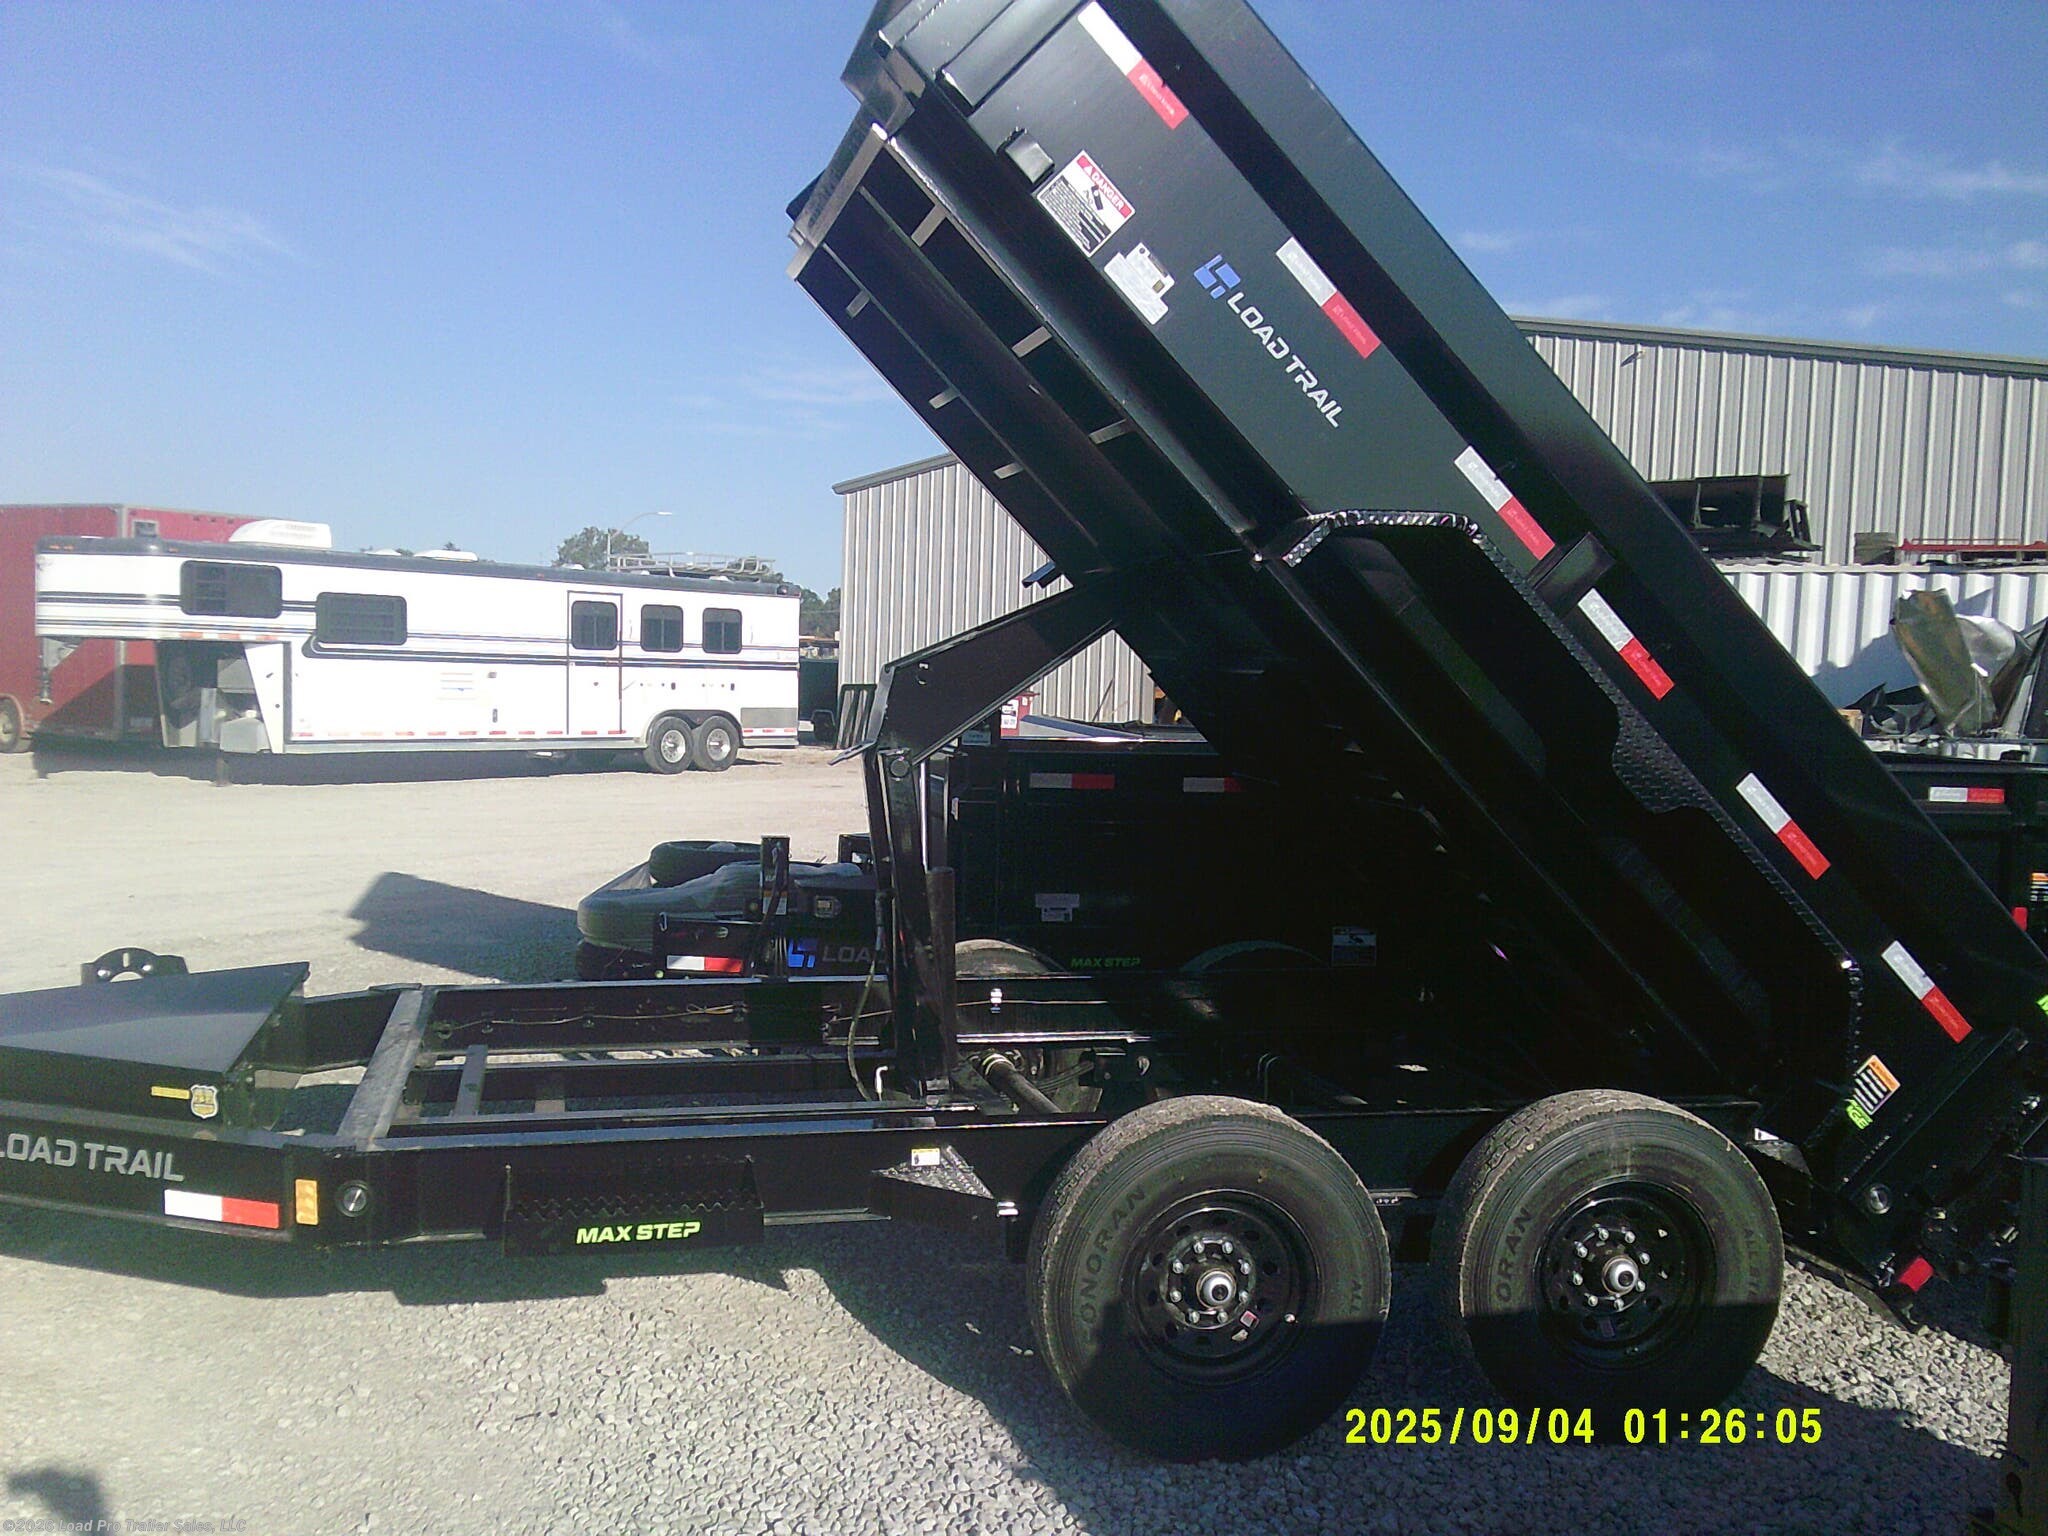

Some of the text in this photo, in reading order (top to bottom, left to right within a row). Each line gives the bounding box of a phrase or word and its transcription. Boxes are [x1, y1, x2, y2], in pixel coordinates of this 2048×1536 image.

[1091, 172, 1126, 212] DANGER
[1227, 291, 1290, 360] LOAD
[1285, 354, 1343, 428] TRAIL
[1071, 957, 1141, 969] MAX STEP
[0, 1133, 185, 1183] OAD TRAIL
[576, 1221, 701, 1245] MAX STEP
[1079, 1184, 1146, 1325] ONORAN
